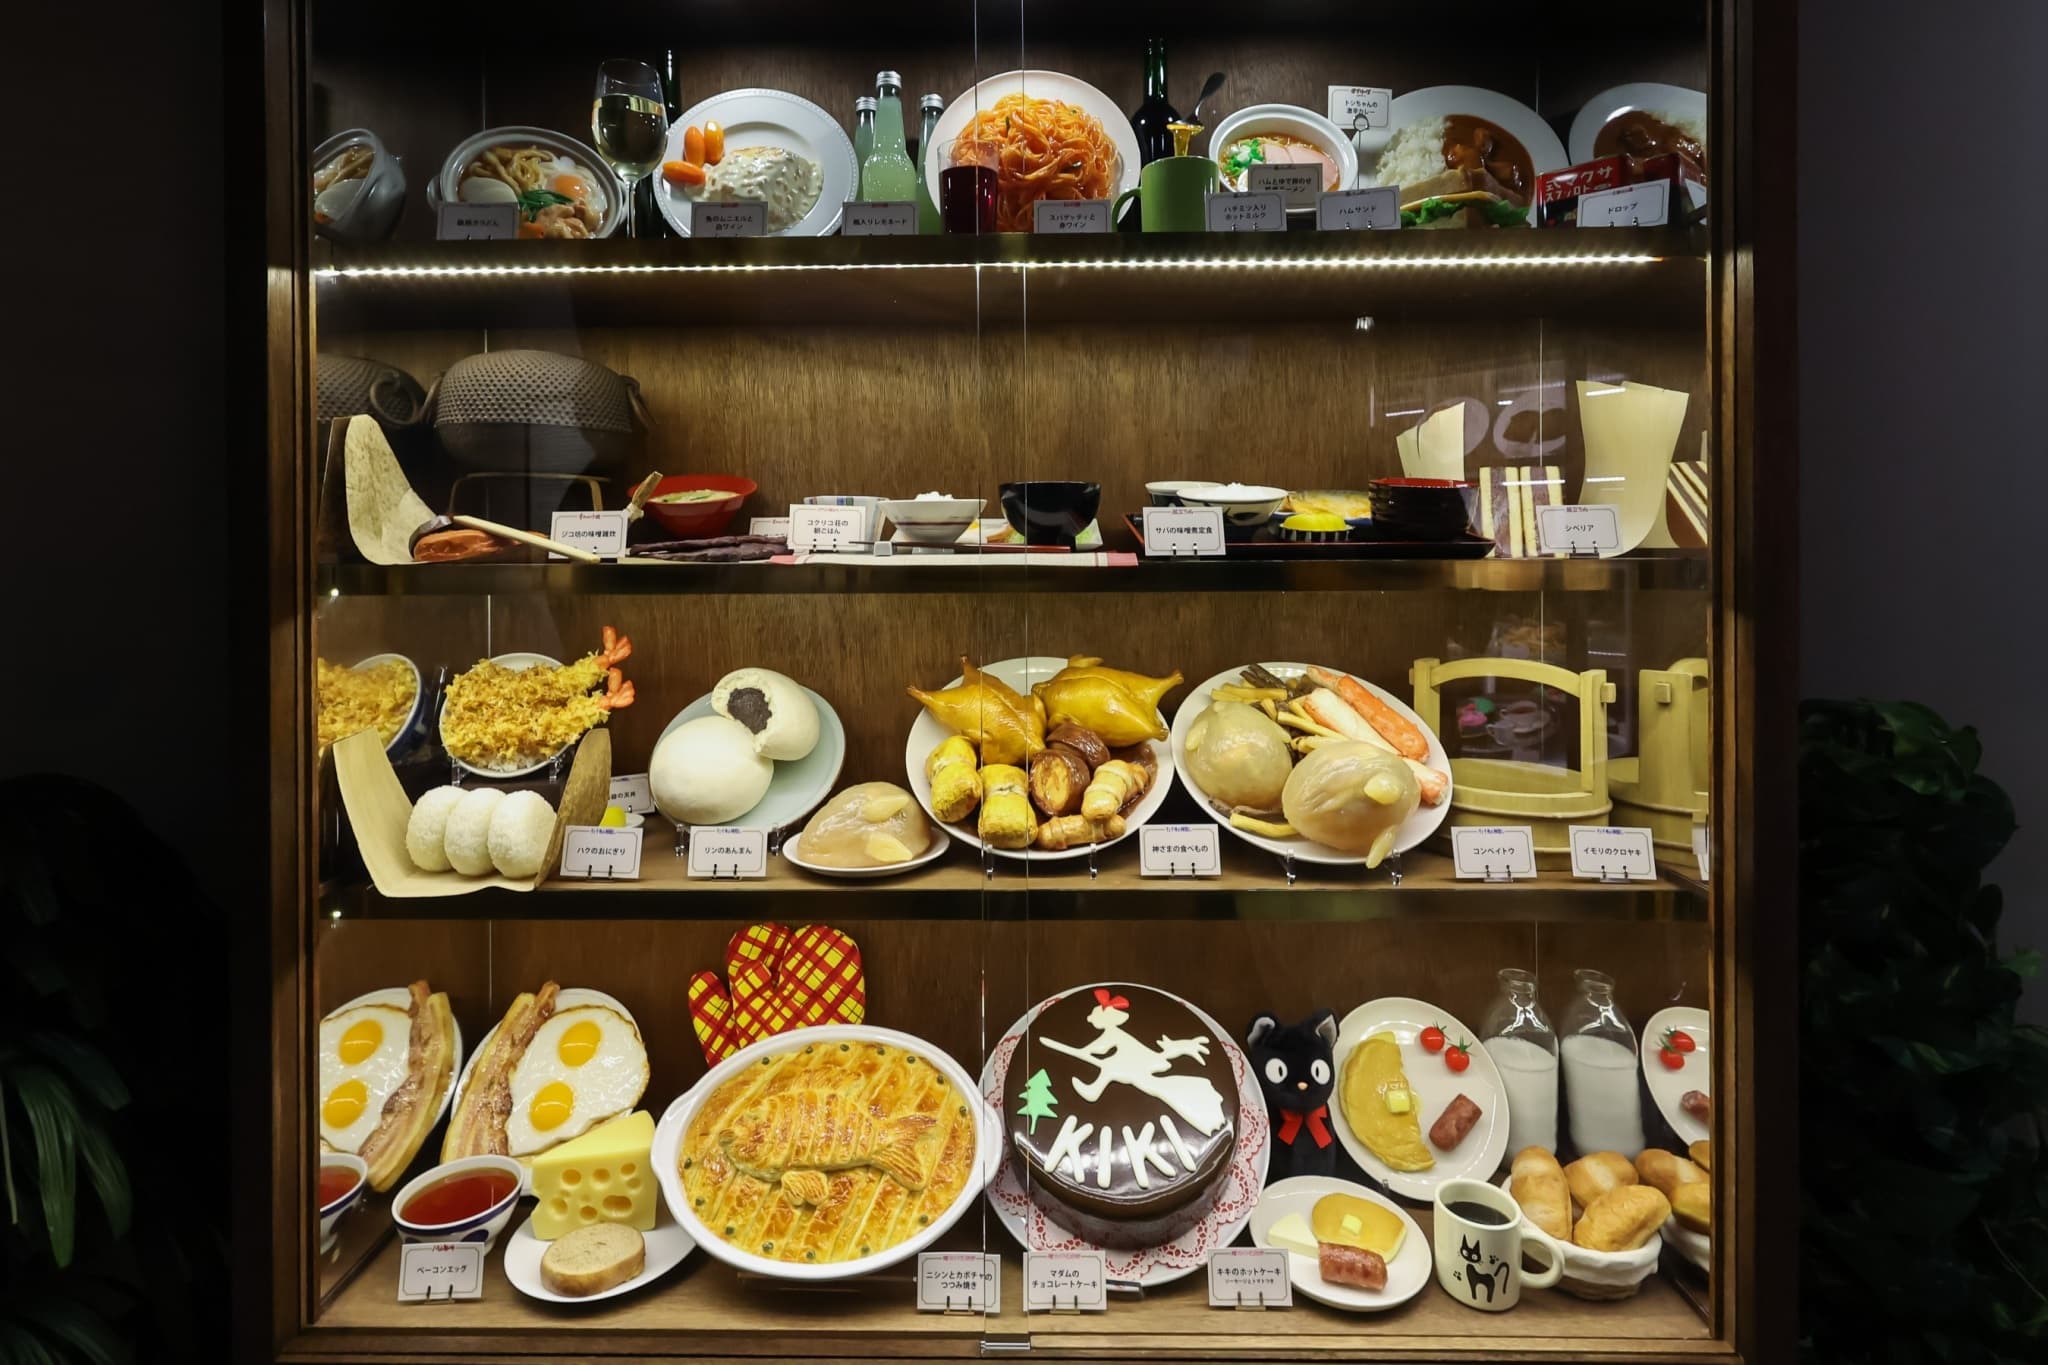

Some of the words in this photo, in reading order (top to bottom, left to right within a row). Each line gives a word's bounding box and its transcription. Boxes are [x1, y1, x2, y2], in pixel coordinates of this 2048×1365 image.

[807, 519, 849, 527] コクリコ荘の
[1565, 524, 1595, 532] シベリア
[576, 847, 626, 856] ハクのおにぎり
[704, 847, 753, 856] リンのあんまん
[1152, 845, 1209, 854] 神さまの食べもの
[1583, 847, 1642, 857] イモリのクロヤキ
[1043, 1114, 1197, 1190] KIKI
[416, 1264, 468, 1275] ベーコンエッグ
[1050, 1269, 1080, 1278] マダムの
[1217, 1267, 1282, 1277] キキのホットケーキ
[925, 1270, 993, 1282] ニシンとカボチャの
[940, 1281, 977, 1291] つつみ焼き
[1031, 1280, 1098, 1289] チョコレートケーキ
